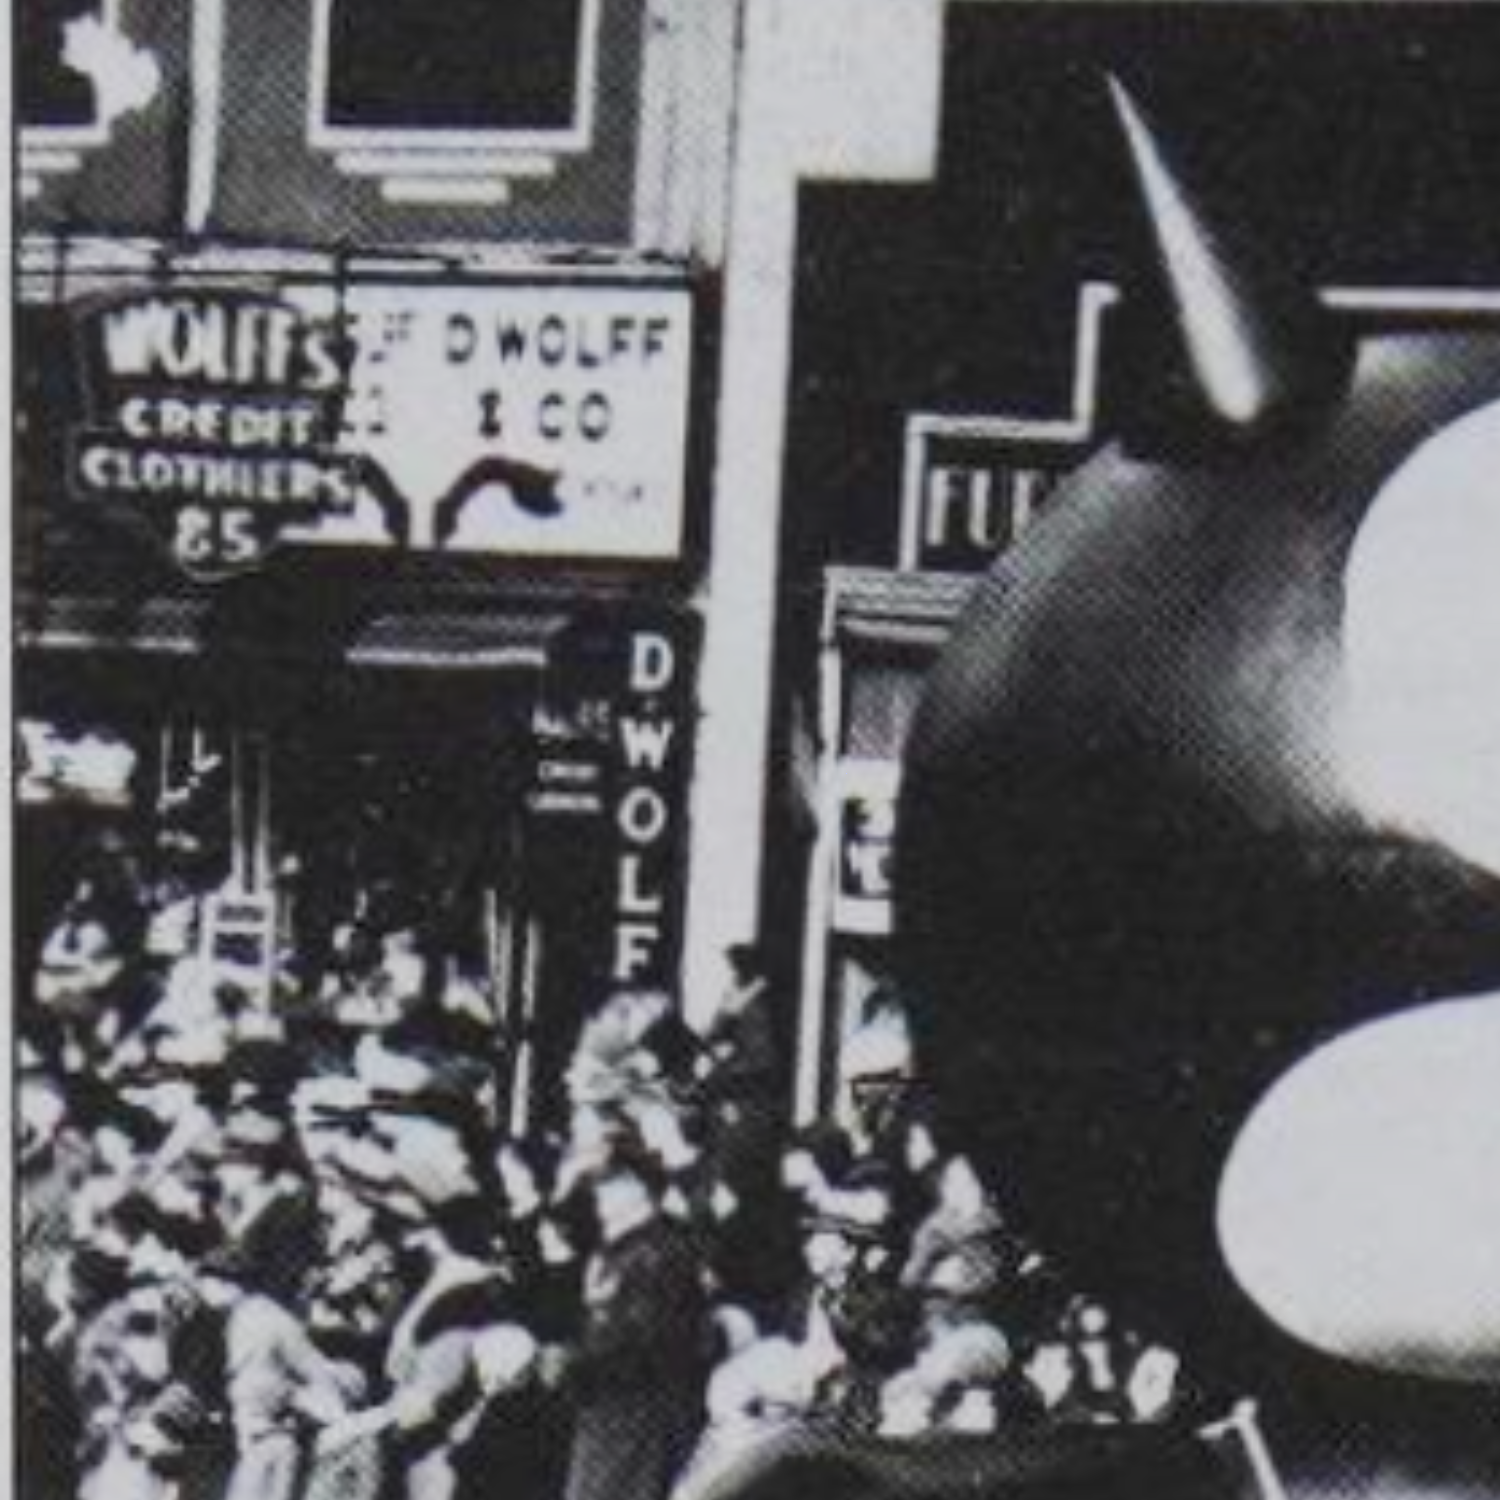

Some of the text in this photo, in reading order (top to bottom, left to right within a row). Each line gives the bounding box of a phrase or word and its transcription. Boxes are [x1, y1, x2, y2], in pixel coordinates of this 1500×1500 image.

[496, 313, 670, 367] WOLFF
[120, 397, 314, 447] CREDIT
[80, 446, 352, 503] CLOTHIERS
